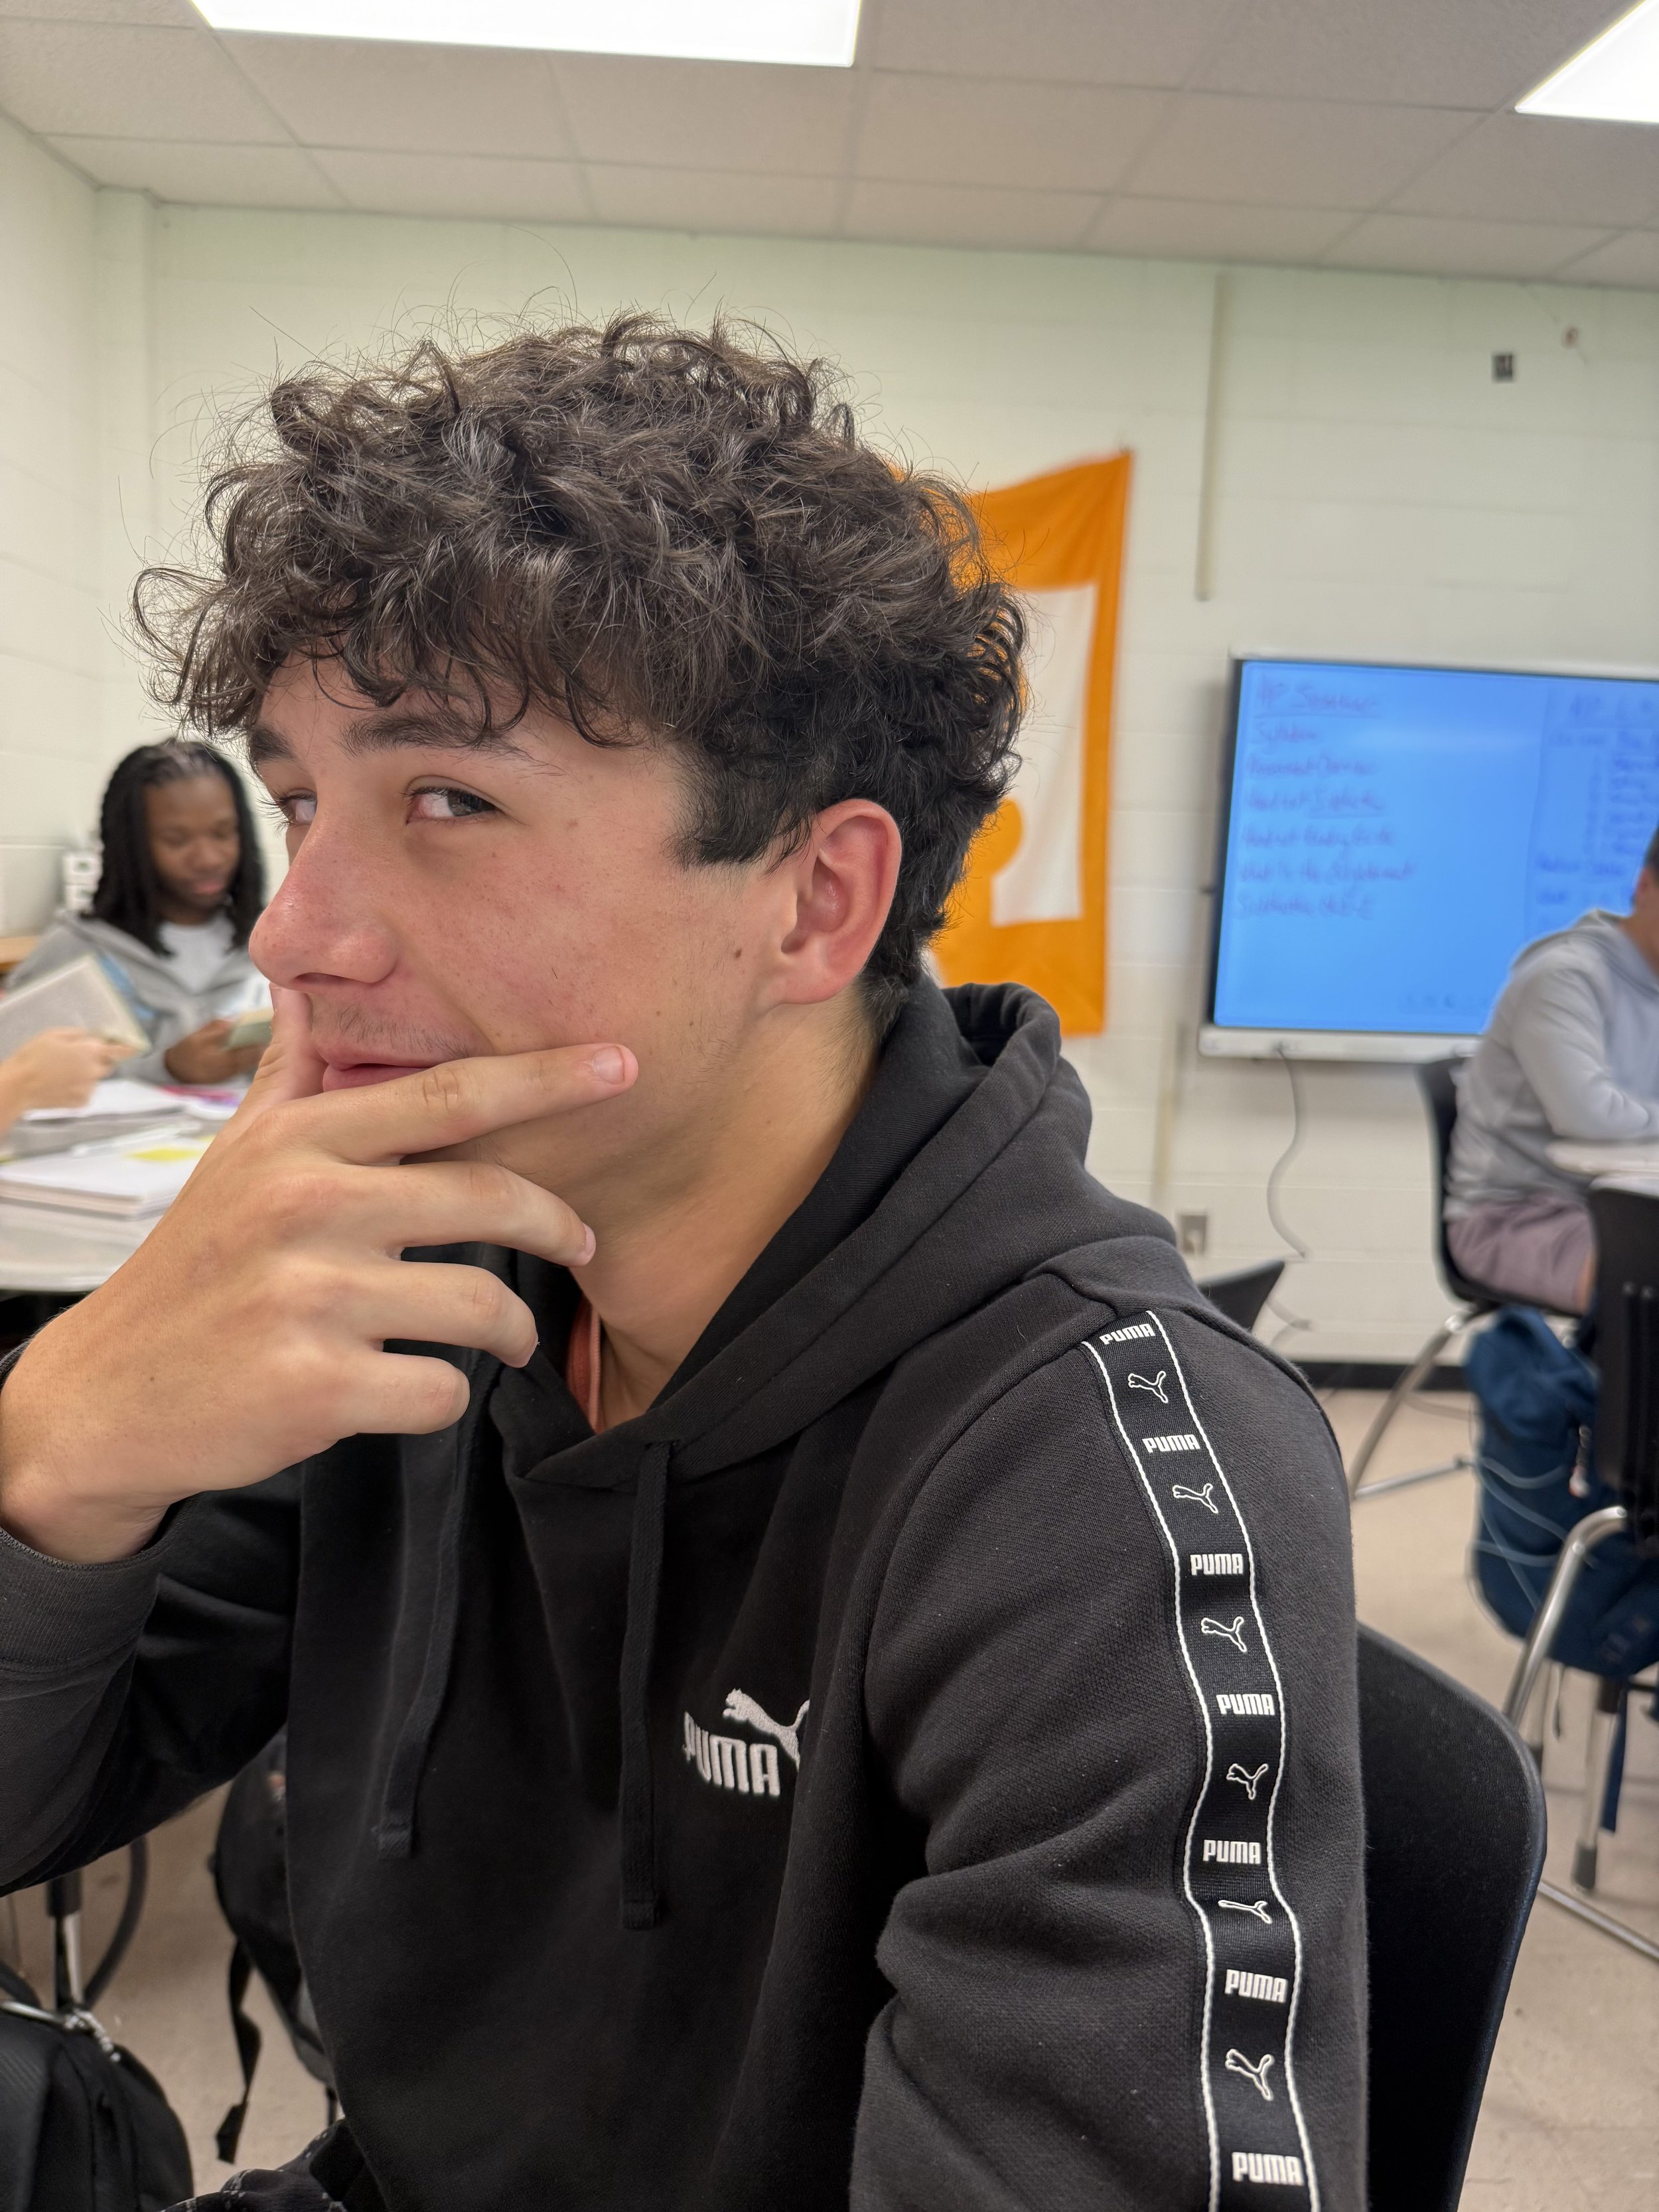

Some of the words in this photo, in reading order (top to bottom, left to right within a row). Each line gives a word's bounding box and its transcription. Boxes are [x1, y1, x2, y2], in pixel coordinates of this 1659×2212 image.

[1100, 1323, 1156, 1345] PUMA
[1142, 1434, 1200, 1453] PUMA
[1190, 1553, 1244, 1576] PUMA
[1216, 1693, 1275, 1716] PUMA
[684, 1711, 781, 1797] PUMA
[1202, 1839, 1261, 1864] PUMA
[1225, 1969, 1287, 2003] PUMA
[1232, 2152, 1305, 2186] PUMA
